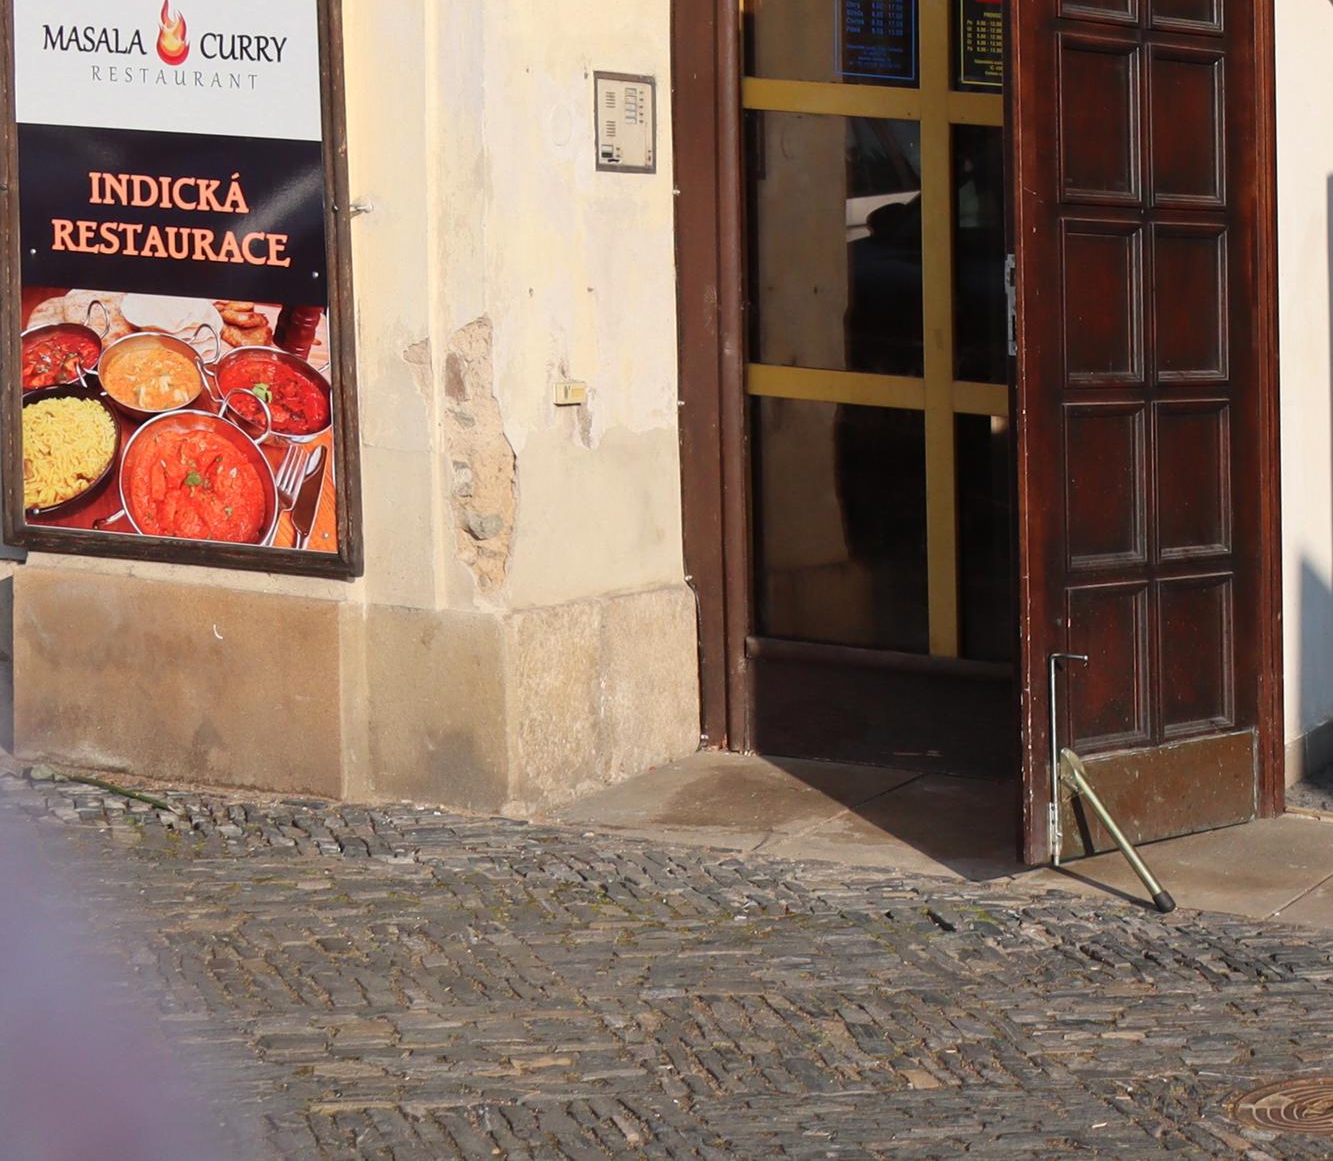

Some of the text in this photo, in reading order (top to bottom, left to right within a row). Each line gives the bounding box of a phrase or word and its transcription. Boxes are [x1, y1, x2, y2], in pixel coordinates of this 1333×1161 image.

[42, 24, 287, 62] MASALA CURRY
[91, 65, 258, 90] RESTAURANT
[88, 172, 250, 214] INDICKÁ
[51, 218, 291, 268] RESTAURACE
